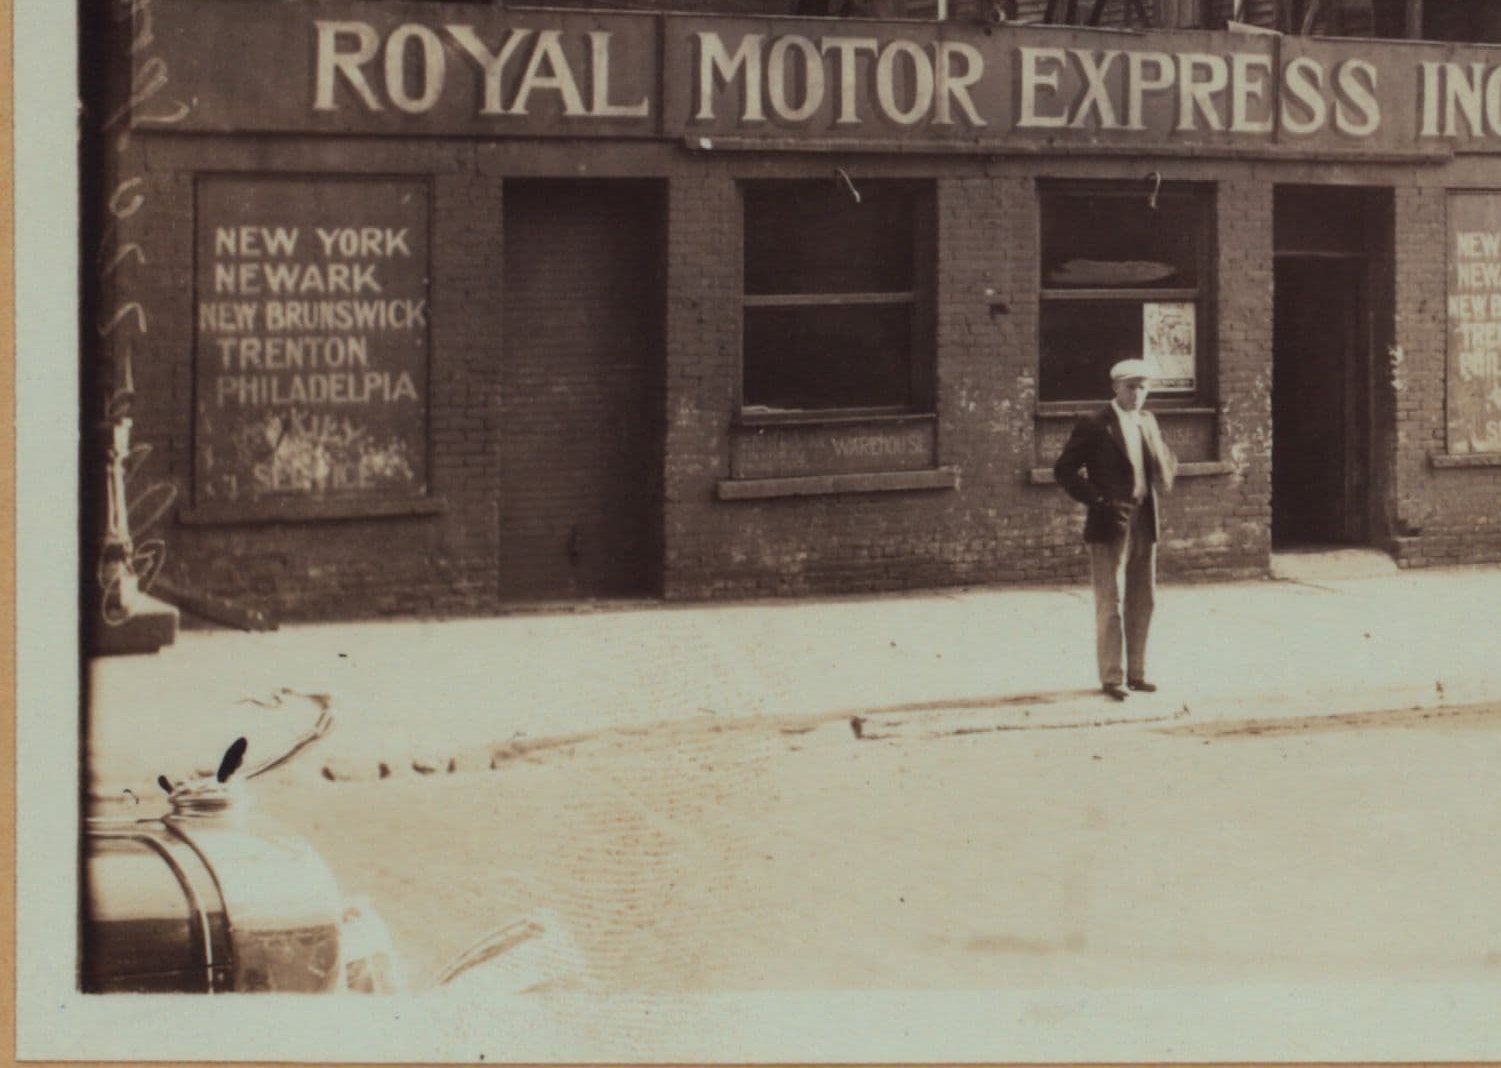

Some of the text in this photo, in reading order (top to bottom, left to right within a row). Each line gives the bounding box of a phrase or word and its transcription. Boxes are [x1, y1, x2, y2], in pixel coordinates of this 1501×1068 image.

[312, 20, 650, 118] ROYAL
[694, 31, 989, 129] MOTOR
[1015, 47, 1382, 138] EXPRESS
[214, 224, 413, 260] NEW YORK
[1456, 231, 1501, 258] NEW
[214, 261, 384, 295] NEWARK
[199, 297, 427, 332] NEW BRUNSWICK
[1447, 291, 1486, 317] NEW
[216, 335, 370, 370] TRENTON
[215, 370, 421, 409] PHILADELPIA
[830, 432, 925, 458] WAREHOUSE
